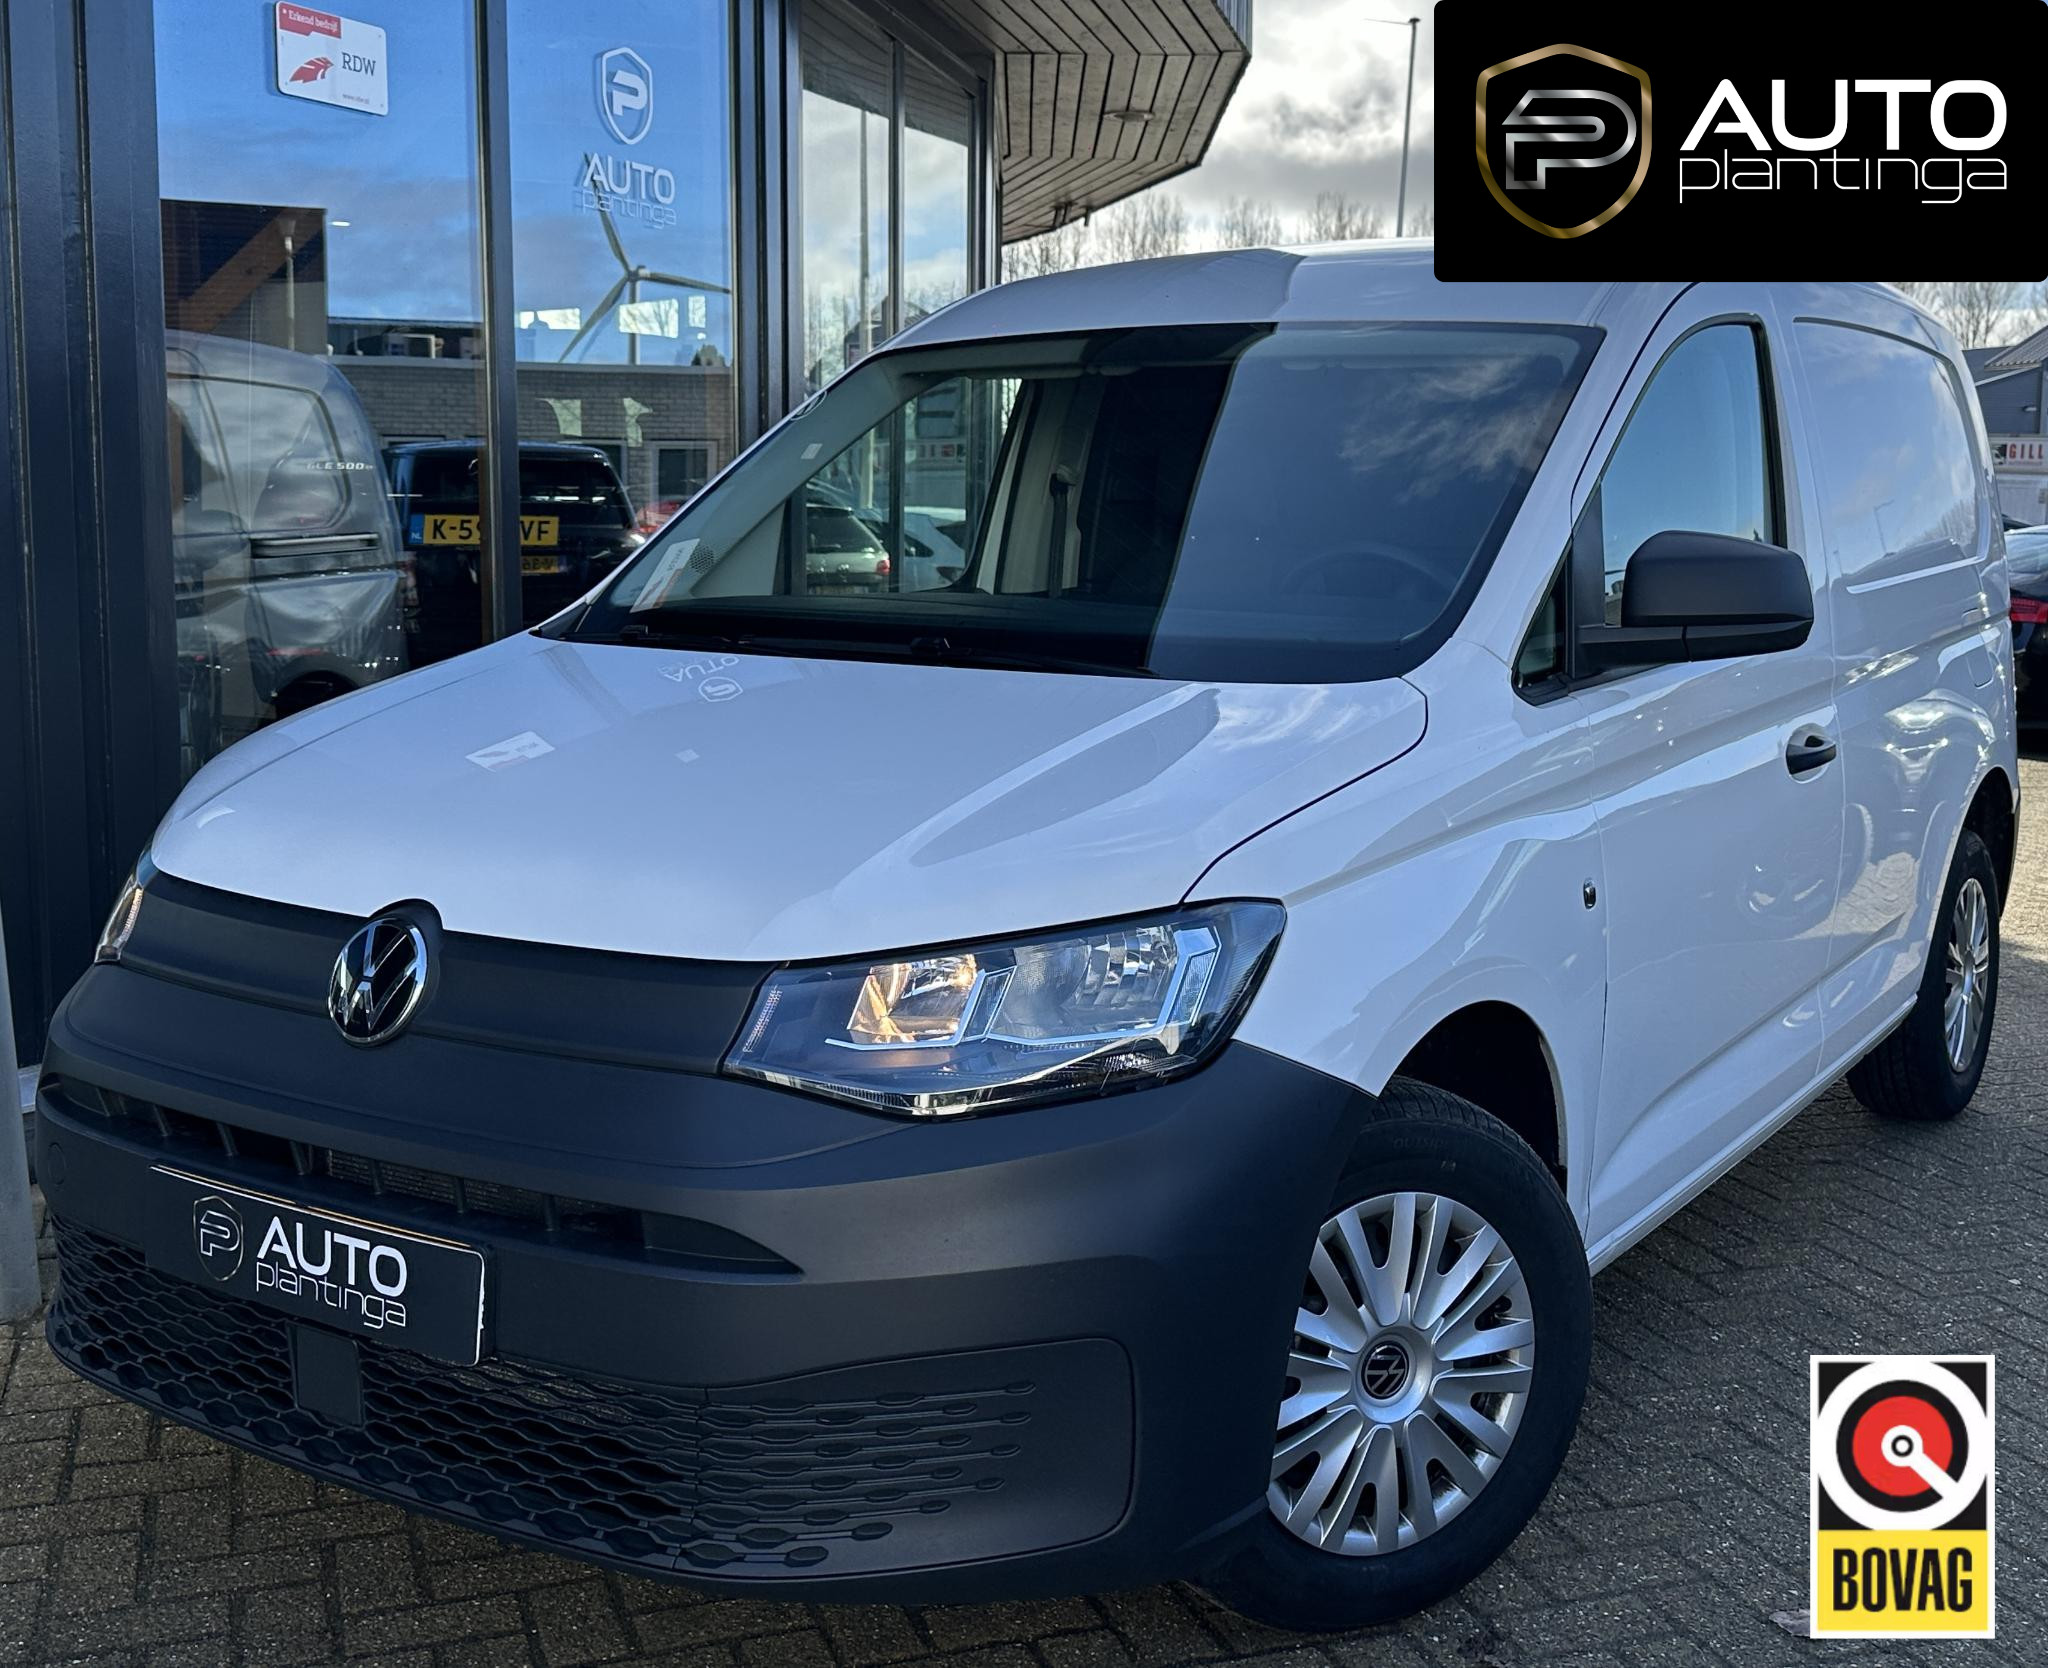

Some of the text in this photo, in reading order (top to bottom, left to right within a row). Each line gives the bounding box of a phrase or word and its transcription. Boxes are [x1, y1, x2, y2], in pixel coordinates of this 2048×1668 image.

[342, 52, 376, 76] RDW
[583, 152, 675, 204] AUTO
[2008, 443, 2043, 459] GILL
[336, 462, 364, 470] 500
[411, 532, 422, 540] NL
[257, 1216, 408, 1297] AUTO
[257, 1261, 406, 1329] plantinga
